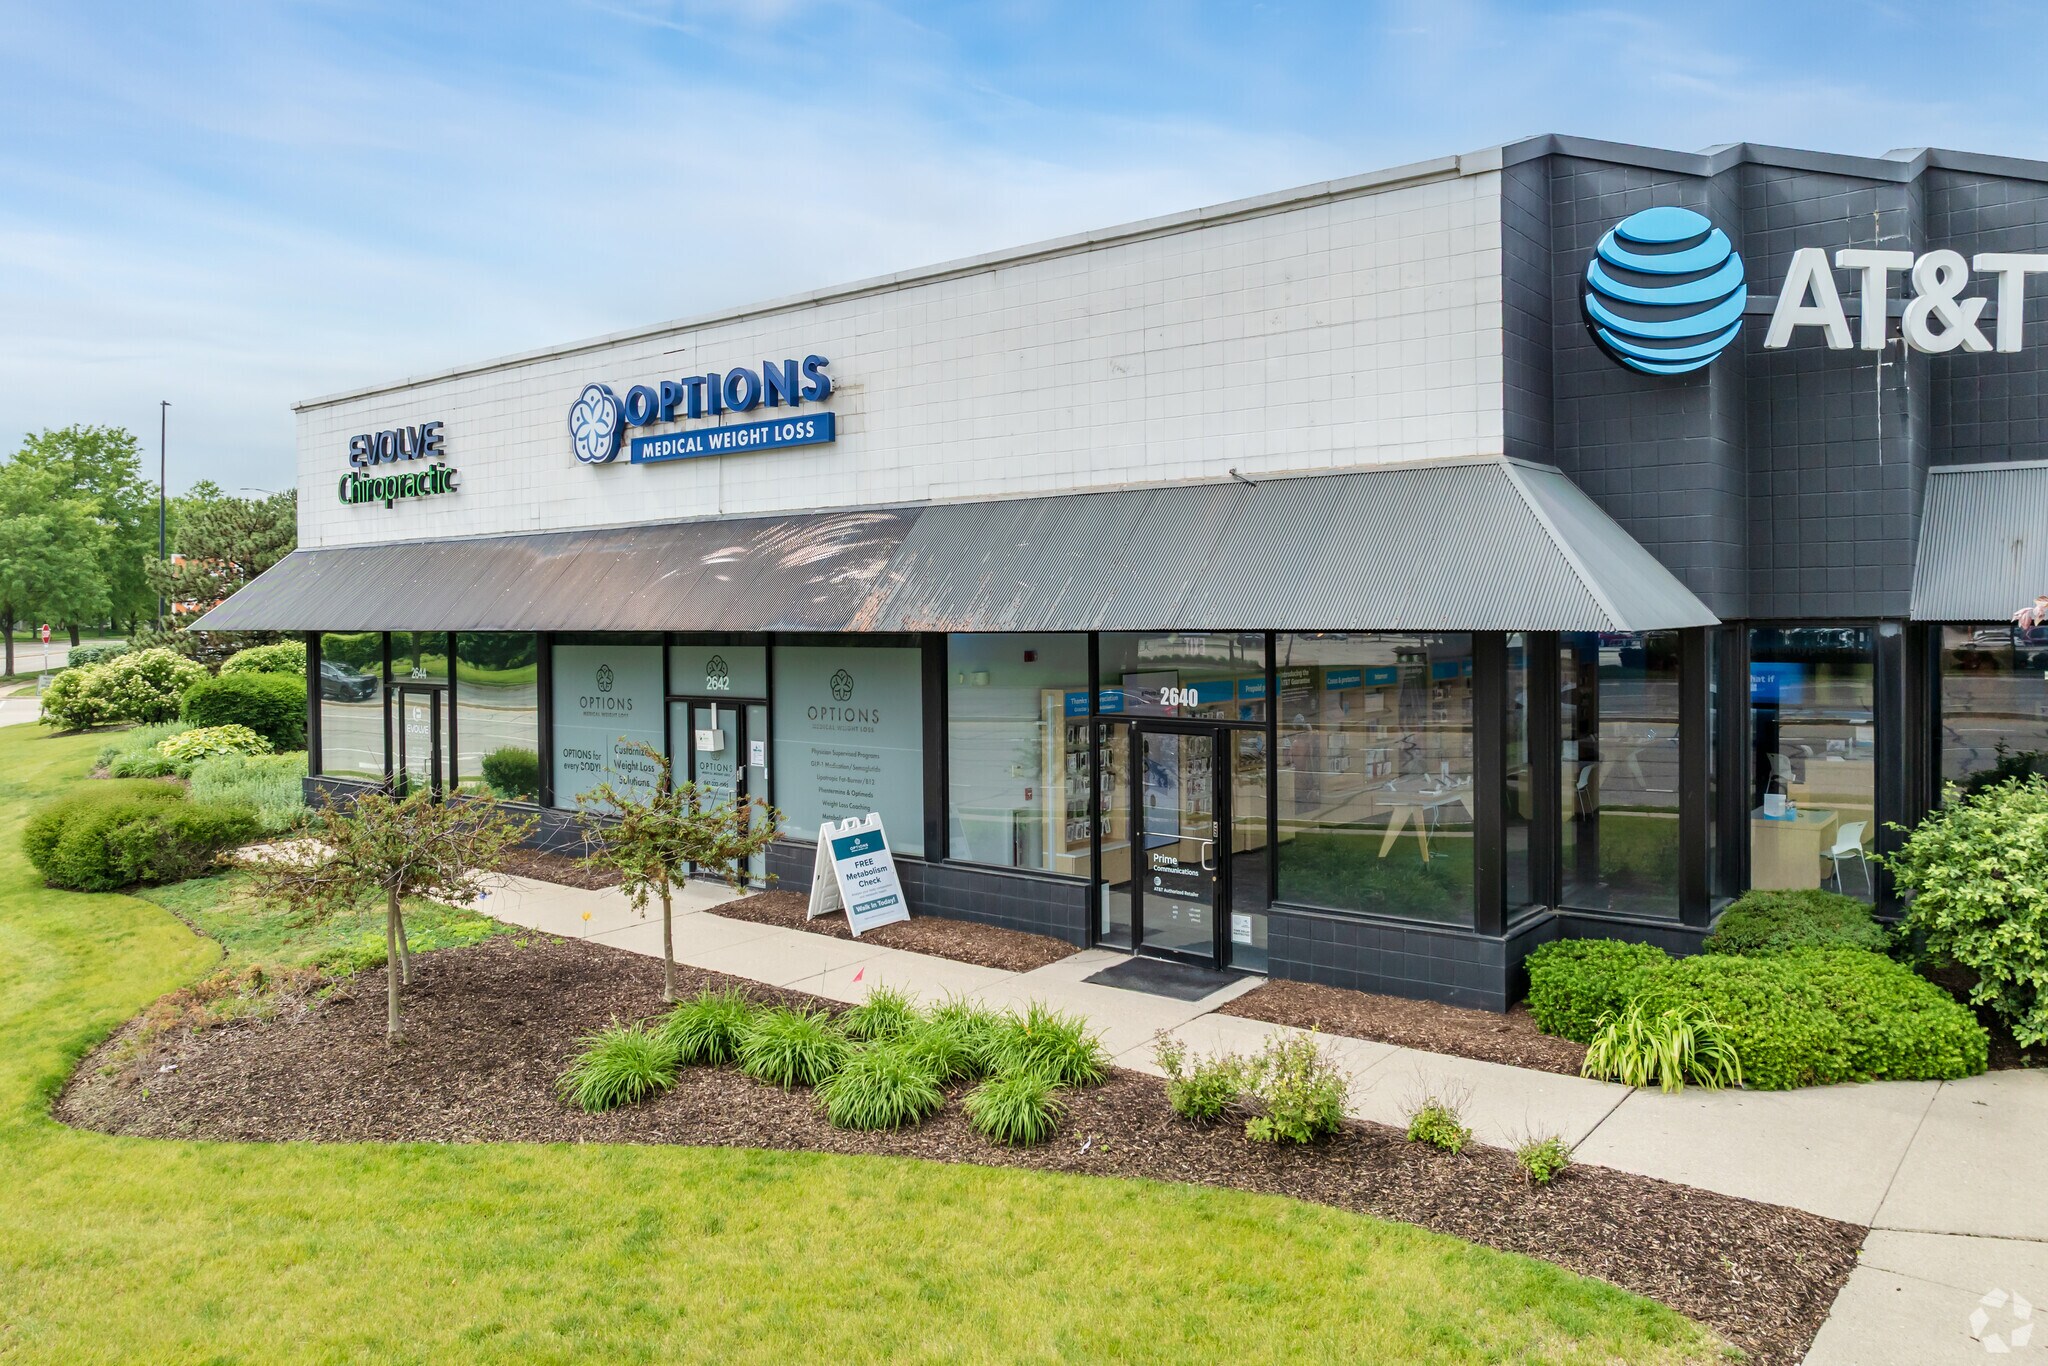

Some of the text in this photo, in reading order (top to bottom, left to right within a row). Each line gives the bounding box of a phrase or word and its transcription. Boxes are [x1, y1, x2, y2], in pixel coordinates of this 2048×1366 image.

[1763, 247, 2048, 354] AT&T
[625, 354, 831, 427] OPTIONS
[349, 421, 444, 468] EVOLVE
[642, 420, 815, 458] MEDICAL WEIGHT LOSS
[338, 462, 457, 509] Chiropractic
[411, 667, 427, 680] 2644
[1750, 675, 1765, 683] hat
[706, 676, 730, 690] 2642
[579, 696, 633, 711] OPTIONS
[1160, 687, 1198, 707] 2640
[808, 706, 879, 724] OPTIONS
[406, 724, 429, 735] EVOLVE
[563, 748, 602, 761] OPTIONS for
[614, 744, 653, 757] Customize
[857, 751, 880, 760] Programs
[564, 763, 579, 773] every
[614, 760, 655, 773] Weight Loss
[699, 761, 733, 773] OPTIONS
[618, 774, 650, 788] Solutions
[822, 800, 871, 812] Weight Loss Coaching
[854, 857, 874, 869] FREE
[1153, 853, 1178, 865] Prime
[846, 865, 888, 881] Metabolism
[1153, 864, 1199, 877] Communications
[858, 876, 882, 888] Check
[1163, 887, 1184, 896] Authorized
[855, 903, 871, 913] Walk
[877, 896, 896, 907] Today!
